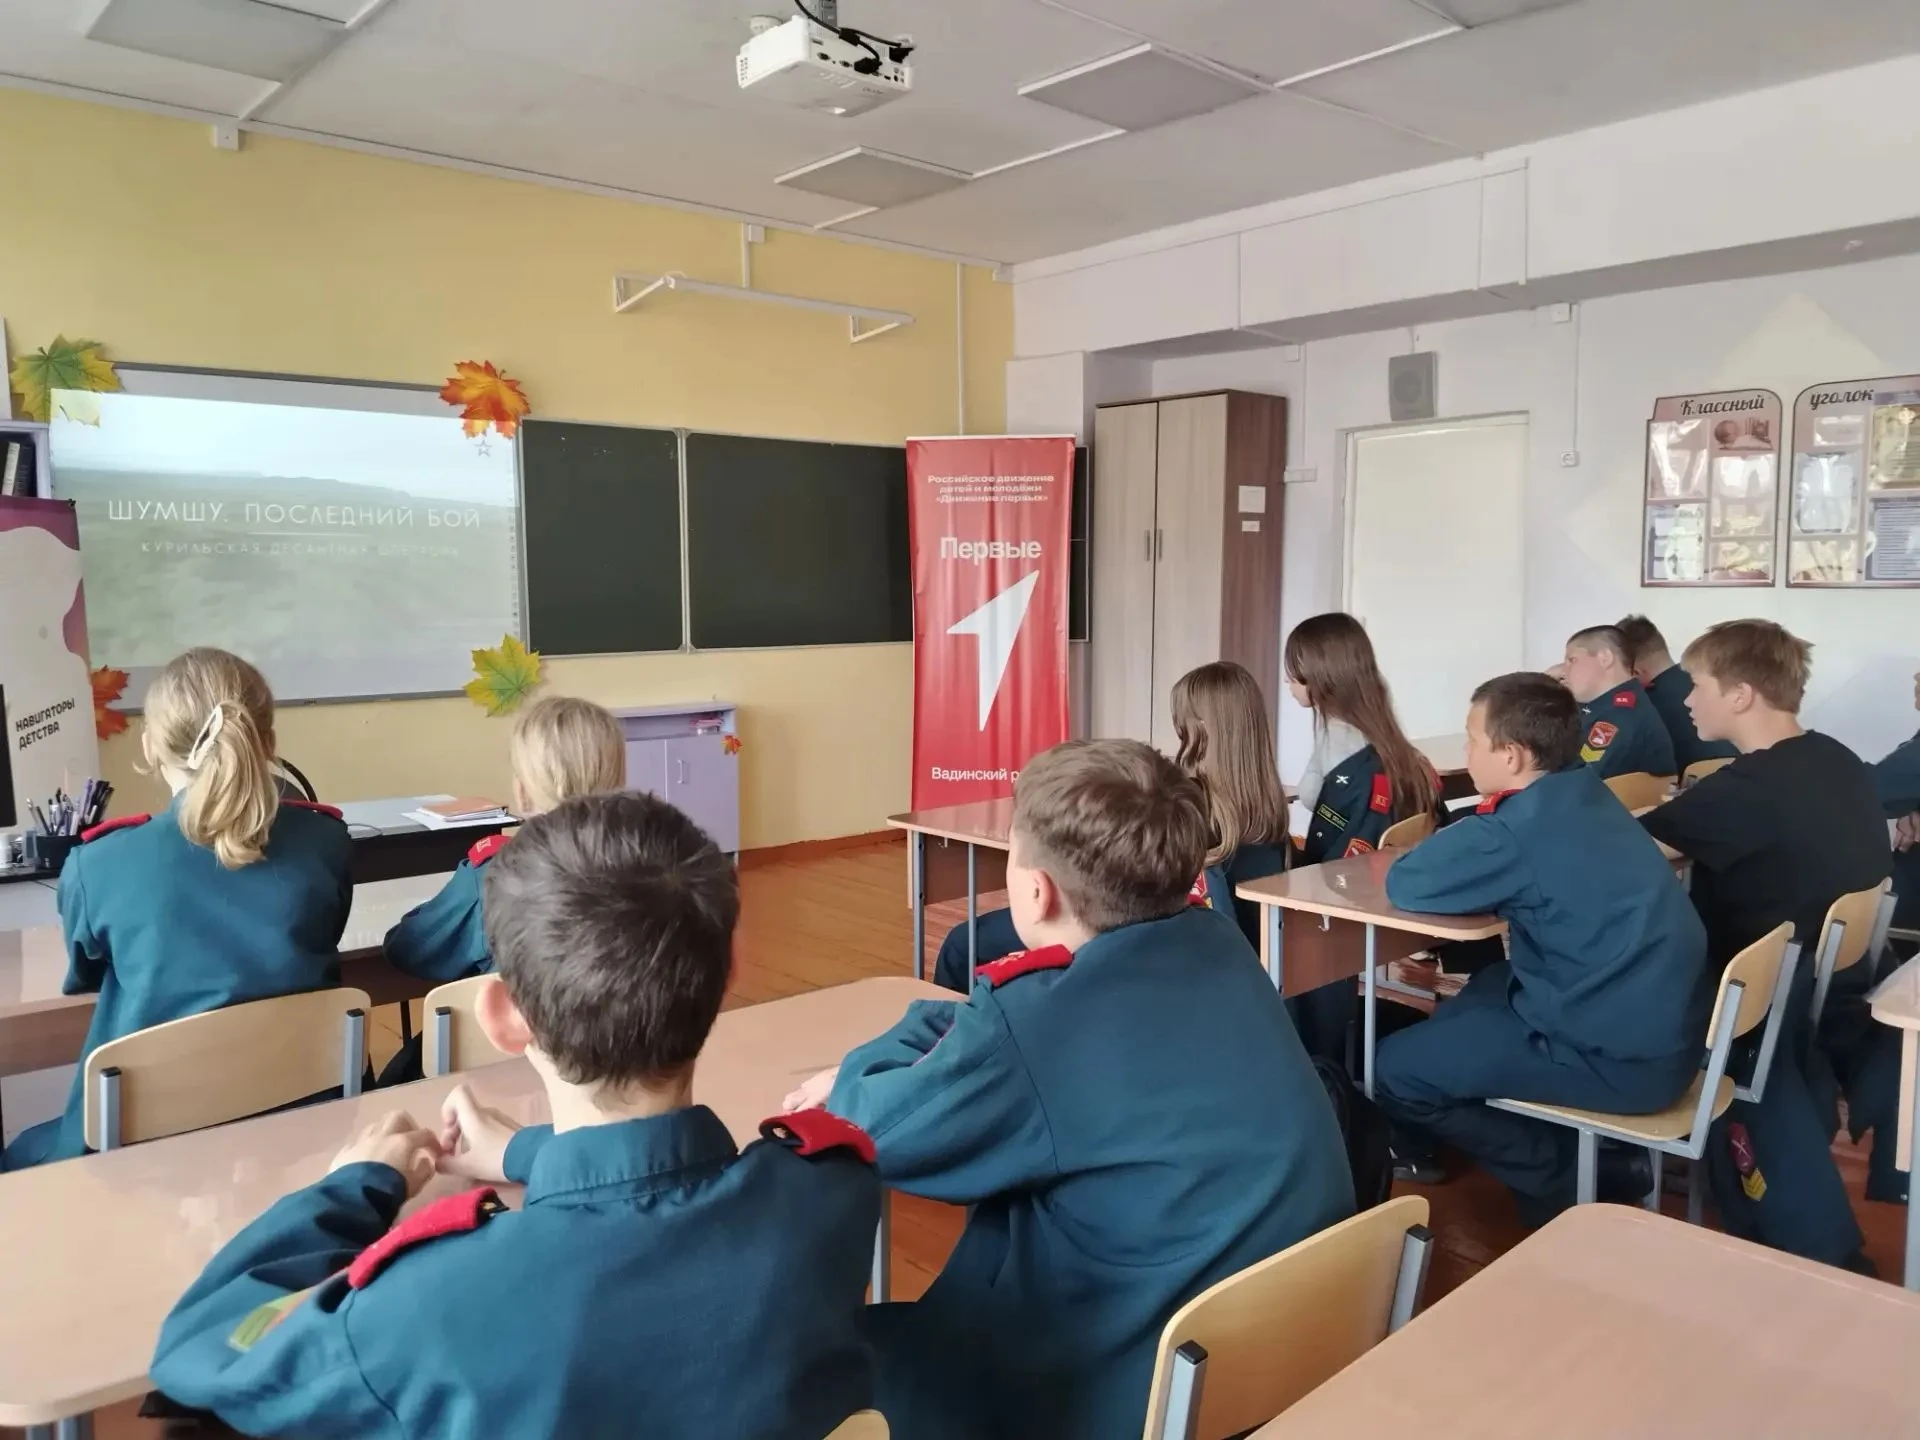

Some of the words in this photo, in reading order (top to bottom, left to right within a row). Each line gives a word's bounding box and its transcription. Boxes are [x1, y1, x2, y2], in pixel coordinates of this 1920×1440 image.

[1680, 395, 1765, 416] Классный
[1810, 388, 1874, 411] уголок
[927, 474, 995, 484] Российское
[996, 474, 1055, 485] движение
[108, 499, 228, 523] ШУМШУ.
[245, 502, 414, 528] ПОСЛЕДНИЙ
[427, 507, 480, 529] БОЙ
[940, 536, 1042, 566] Первые
[15, 697, 76, 733] НАВИГАТОРЫ
[18, 720, 61, 752] ДЕТСТВА
[931, 766, 1008, 782] Вадинский
